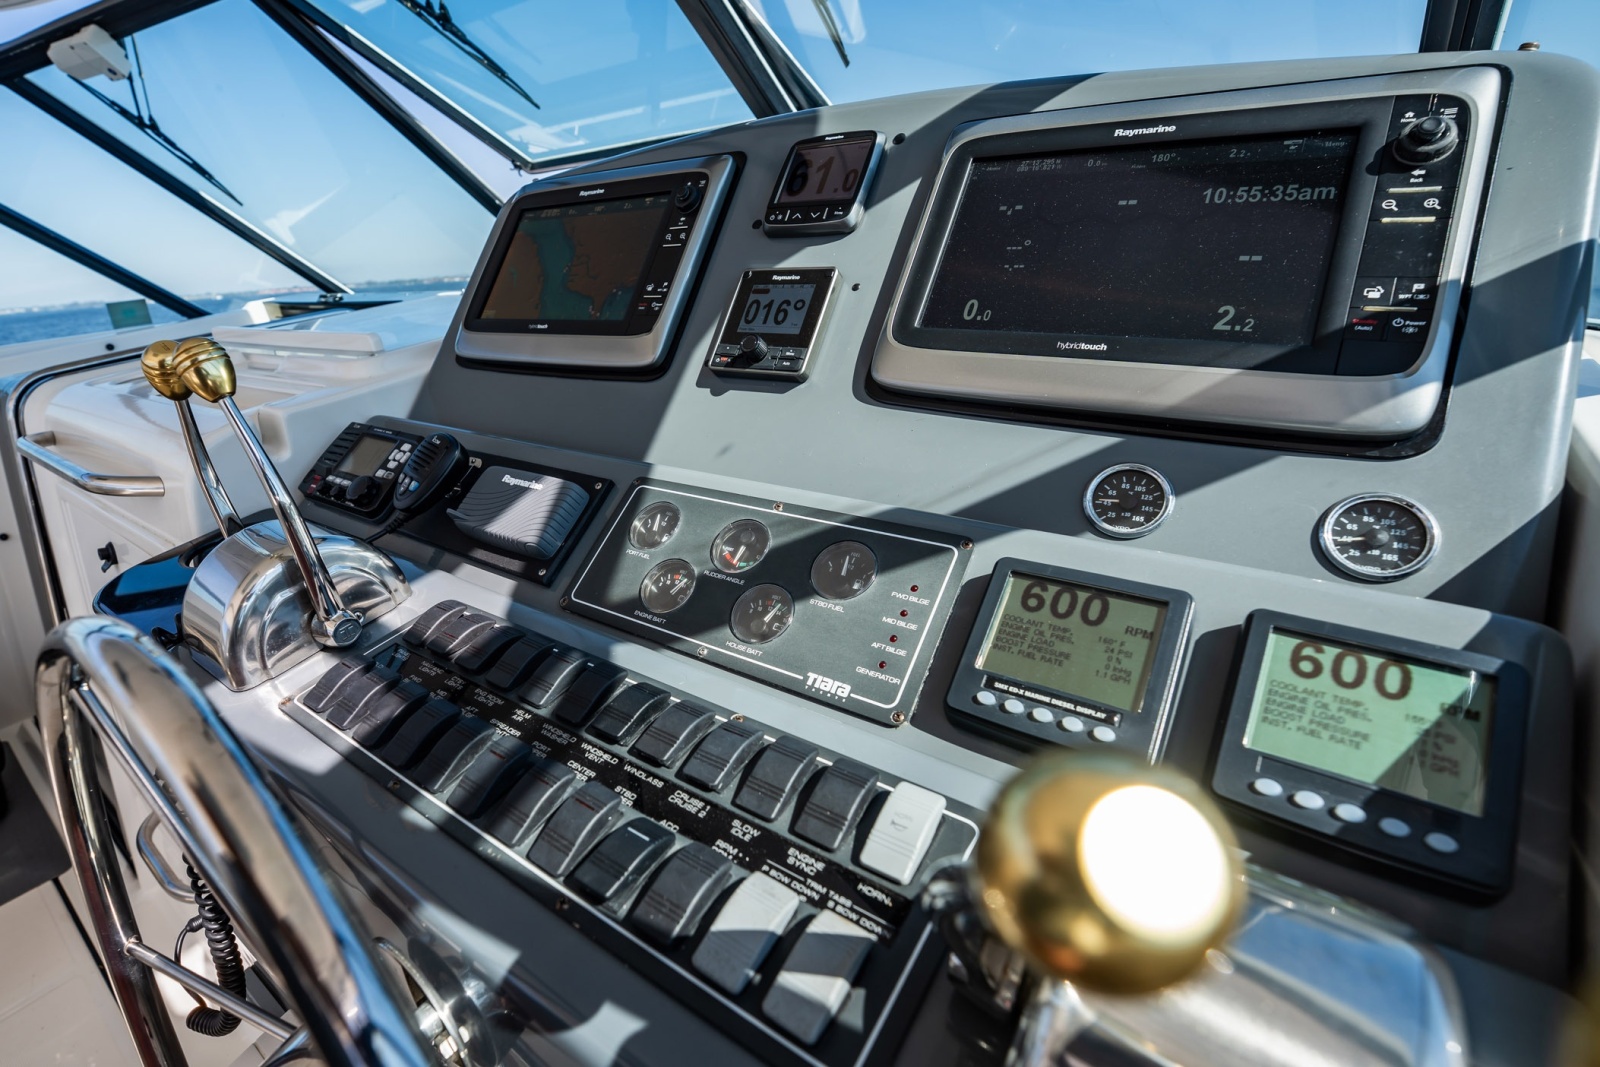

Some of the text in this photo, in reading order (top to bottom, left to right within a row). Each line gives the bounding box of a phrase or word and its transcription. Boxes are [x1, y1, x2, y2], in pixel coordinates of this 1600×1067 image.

[1114, 124, 1176, 137] Raymarine
[1202, 185, 1336, 204] 10:55:35am
[744, 299, 806, 325] 016°
[963, 299, 992, 321] 0.0
[1213, 305, 1255, 332] 2.2
[1056, 341, 1107, 352] hybridtouch
[501, 474, 544, 490] Raymarine
[639, 552, 650, 560] FUEL
[1382, 553, 1399, 561] 165
[704, 570, 745, 586] RUDDER ANGLE
[809, 599, 844, 613] STBD FUEL
[891, 591, 930, 606] FWD BILGE
[1020, 580, 1111, 627] 600
[634, 609, 667, 624] ENGINE BATT
[882, 616, 918, 631] MID BILGE
[1003, 613, 1044, 628] COOLANT
[999, 628, 1028, 641] ENGINE
[1031, 636, 1055, 647] LOAD
[1001, 620, 1031, 633] ENGINE
[1034, 628, 1045, 637] OIL
[1125, 625, 1154, 641] RPM
[725, 641, 763, 657] HOUSE BATT
[871, 639, 908, 657] AFT BILGE
[996, 635, 1024, 647] BOOST
[1028, 643, 1072, 660] PRESSURE
[1017, 649, 1036, 660] FUEL
[1040, 655, 1064, 667] RATE
[856, 666, 901, 685] GENERATOR
[1289, 640, 1413, 701] 600
[444, 679, 463, 690] LIGHTS
[1270, 679, 1327, 699] COOLANT
[474, 688, 505, 706] ENG ROOM
[474, 695, 494, 707] LIGHTS
[1024, 690, 1052, 703] MARINE
[1051, 698, 1075, 711] DIESEL
[1076, 705, 1107, 719] DISPLAY
[1267, 688, 1309, 705] ENGINE
[465, 705, 479, 713] AFT
[511, 714, 524, 722] AIR
[514, 708, 532, 719] HELM
[1265, 697, 1346, 724] ENGINE LOAD
[489, 718, 521, 737] SPREADER
[1263, 706, 1371, 742] BOOST PRESSURE
[540, 729, 568, 745] WASHER
[1296, 726, 1323, 740] FUEL
[1328, 734, 1361, 750] RATE
[532, 741, 552, 753] PORT
[584, 751, 604, 764] VENT
[567, 760, 596, 778] CENTER
[623, 763, 664, 788] WINDLASS
[614, 785, 637, 801] STBD
[674, 790, 705, 809] CRUISE
[668, 795, 707, 819] CRUISE 2
[659, 819, 680, 833] ACC
[730, 827, 752, 842] IDLE
[731, 819, 761, 837] SLOW
[786, 856, 817, 876] SYNC
[787, 847, 826, 872] ENGINE
[769, 869, 791, 884] BOW
[790, 881, 820, 901] DOWN
[805, 878, 853, 908] TRIM TABS
[835, 904, 860, 922] BOW
